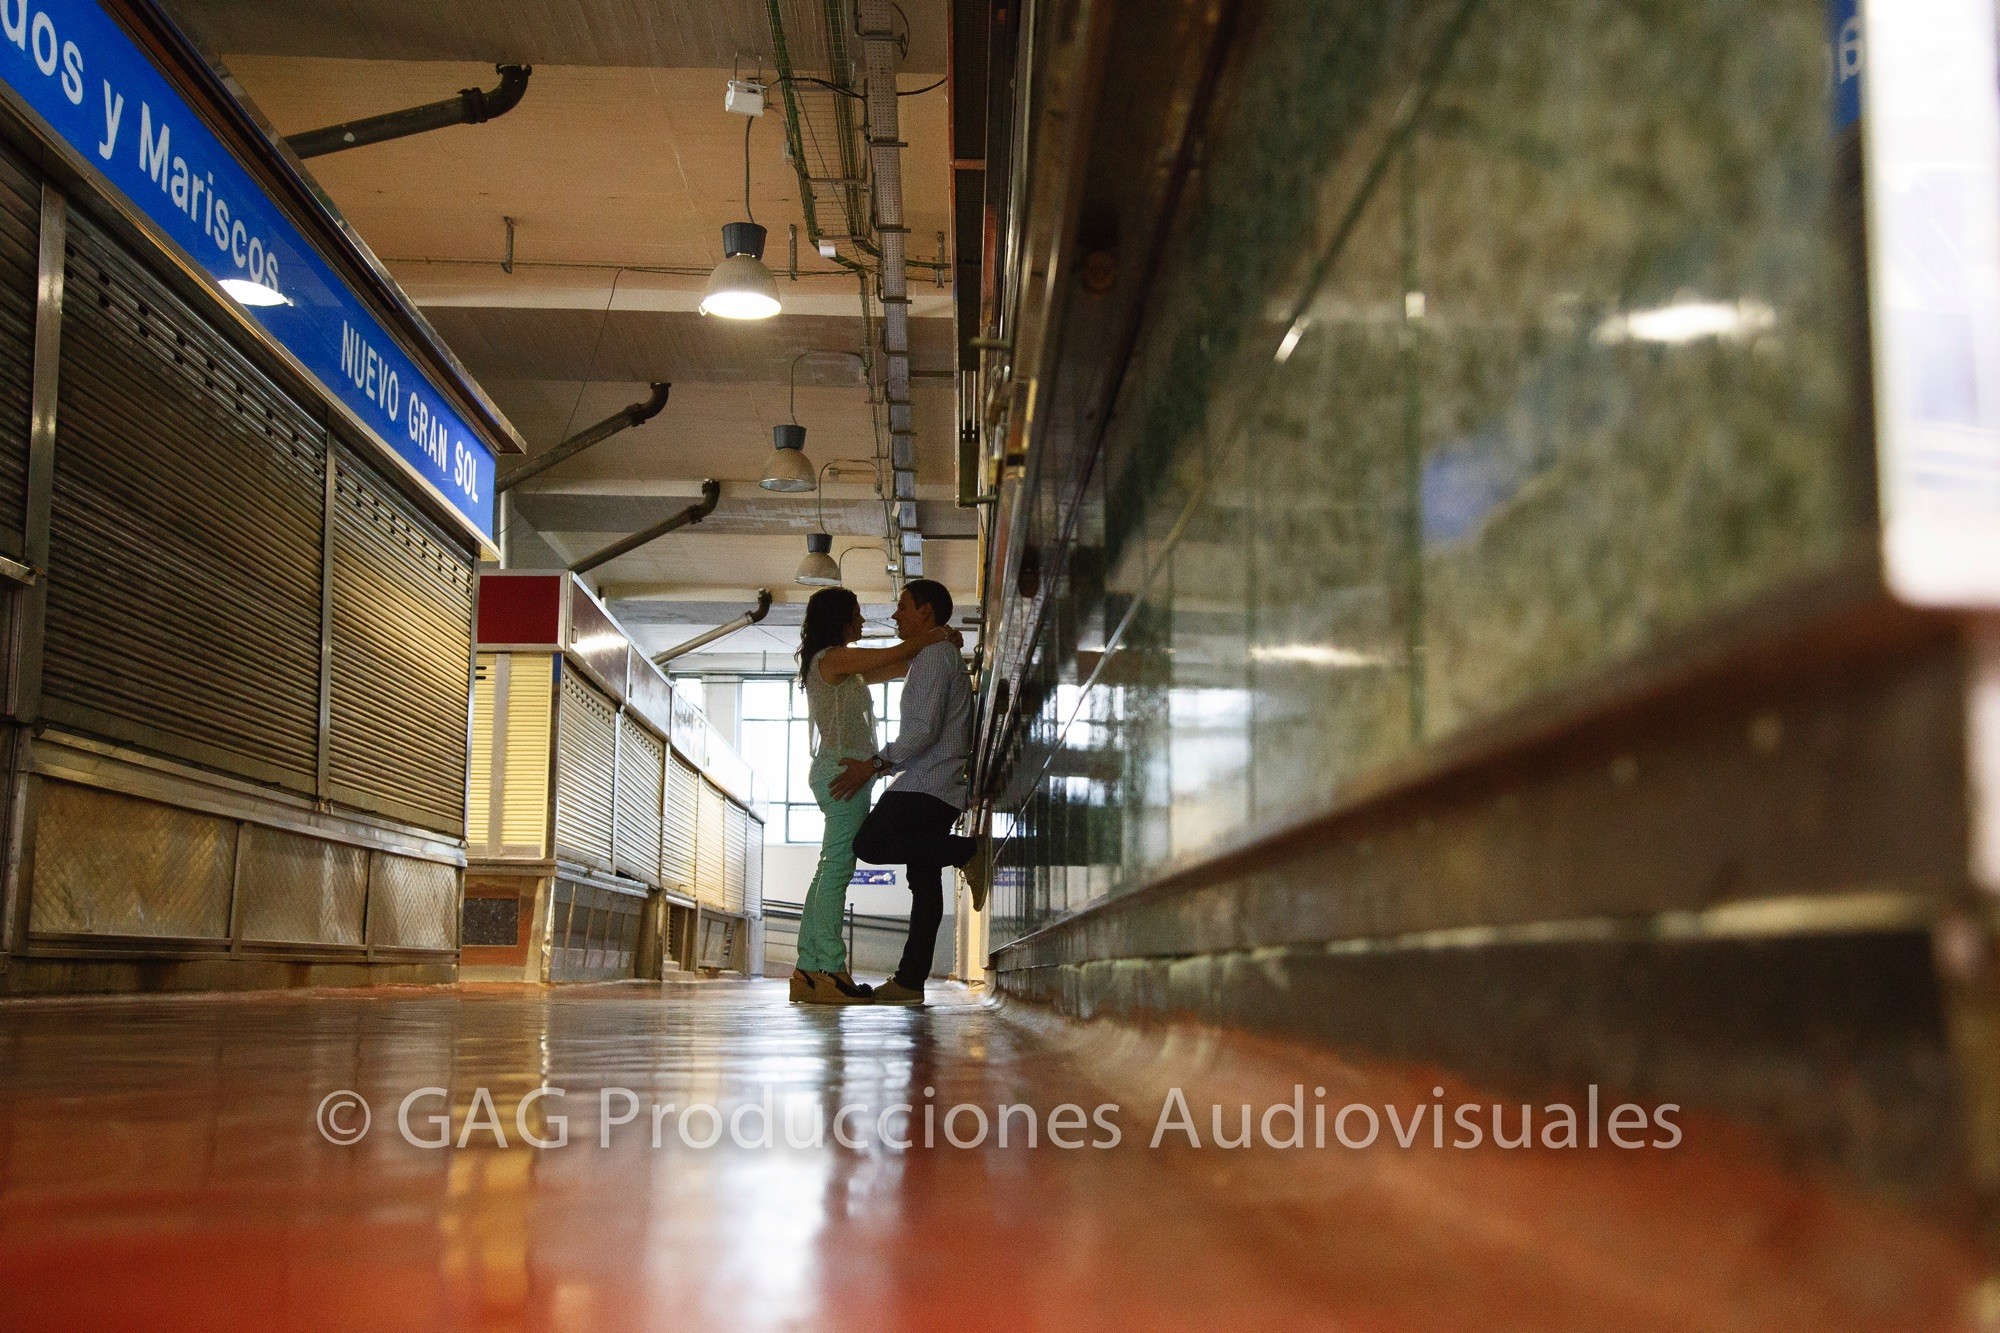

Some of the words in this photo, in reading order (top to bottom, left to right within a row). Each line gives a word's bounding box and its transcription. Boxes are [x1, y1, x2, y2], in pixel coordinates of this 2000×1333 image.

[99, 78, 124, 161] y
[139, 101, 279, 293] Mariscos
[341, 320, 399, 421] NUEVO
[408, 392, 448, 473] GRAN
[454, 440, 479, 504] SOL
